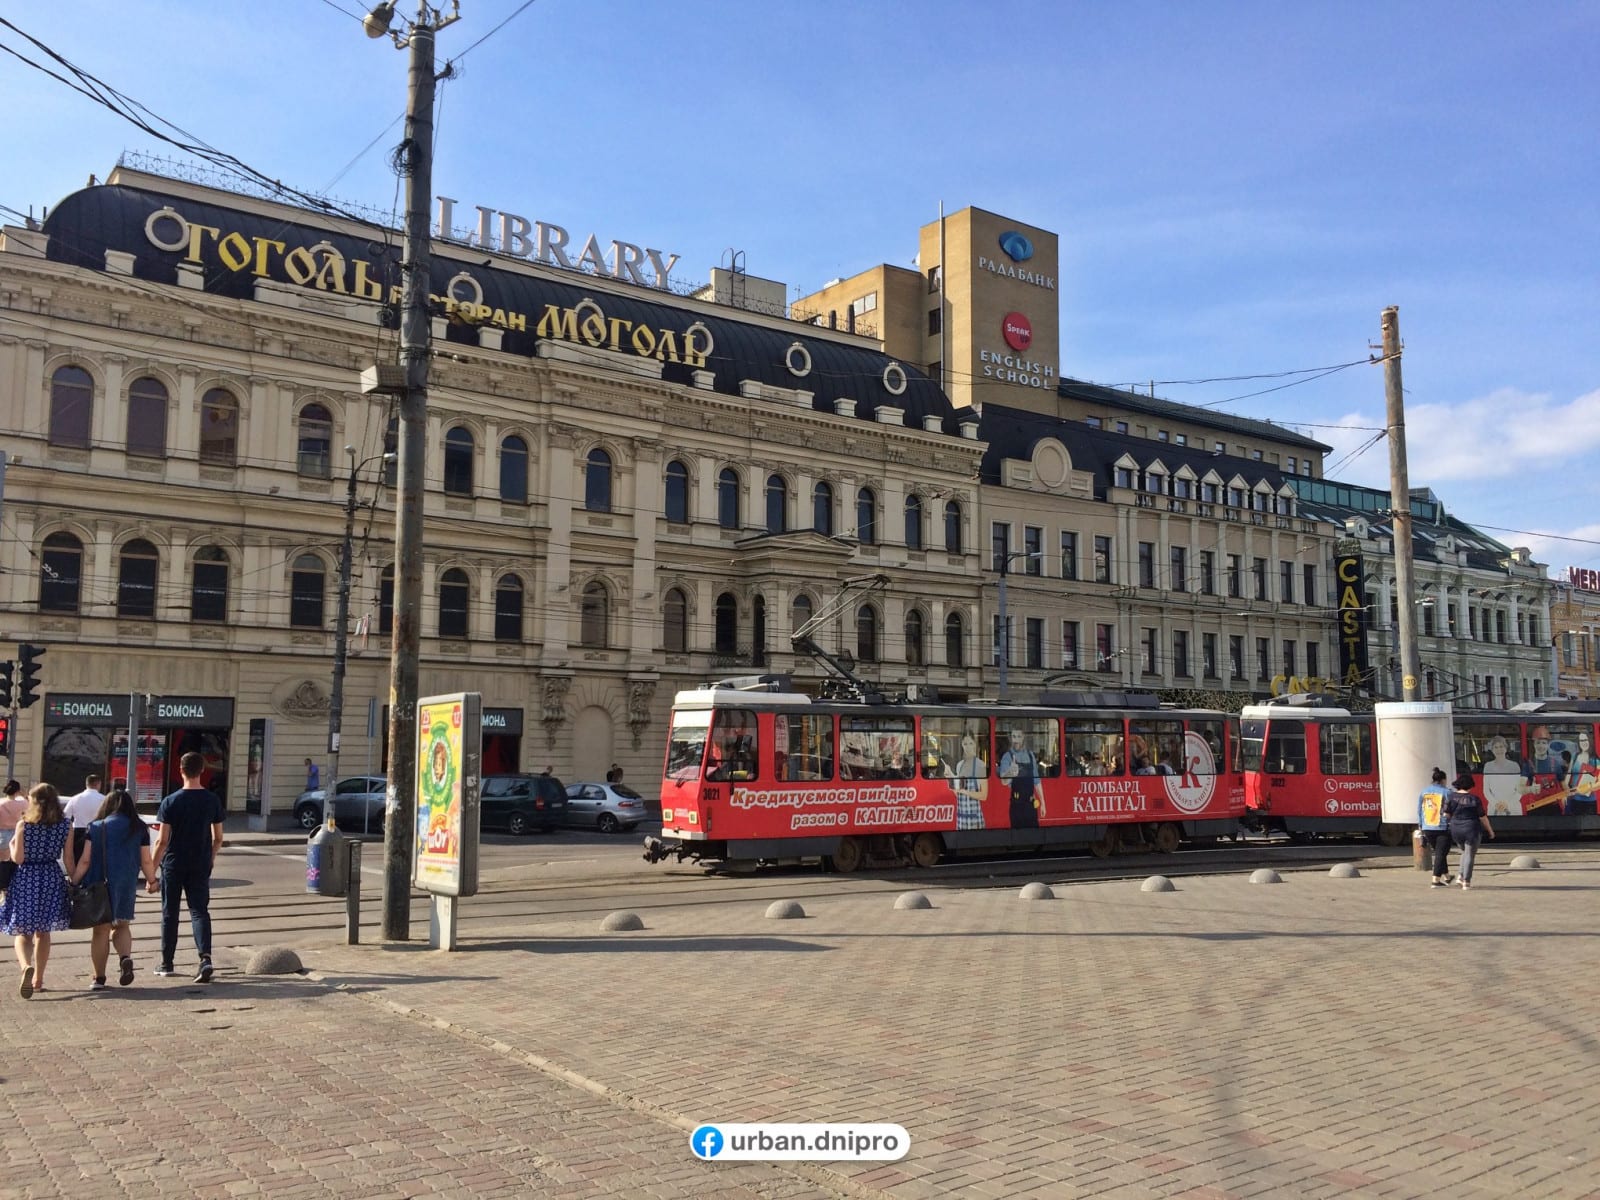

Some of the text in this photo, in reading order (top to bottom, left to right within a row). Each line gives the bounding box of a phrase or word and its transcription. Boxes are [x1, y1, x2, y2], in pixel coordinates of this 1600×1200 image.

[435, 195, 681, 290] LIBRARY
[183, 221, 382, 300] ГОГОЛЬ
[536, 303, 706, 368] МОГОЛЬ
[980, 350, 1054, 377] ENGLISH
[983, 365, 1051, 390] SCHOOL
[1338, 558, 1362, 685] CASTA
[63, 702, 113, 717] БОМОНД
[158, 704, 205, 718] БОМОНД
[730, 785, 917, 809] Кредитуємося вигідно
[1078, 780, 1141, 795] ЛОМБАРД
[1338, 781, 1373, 791] гаряча
[1072, 795, 1147, 813] КАПІТАЛ
[791, 804, 955, 830] разом з КАПІТАЛОМ!
